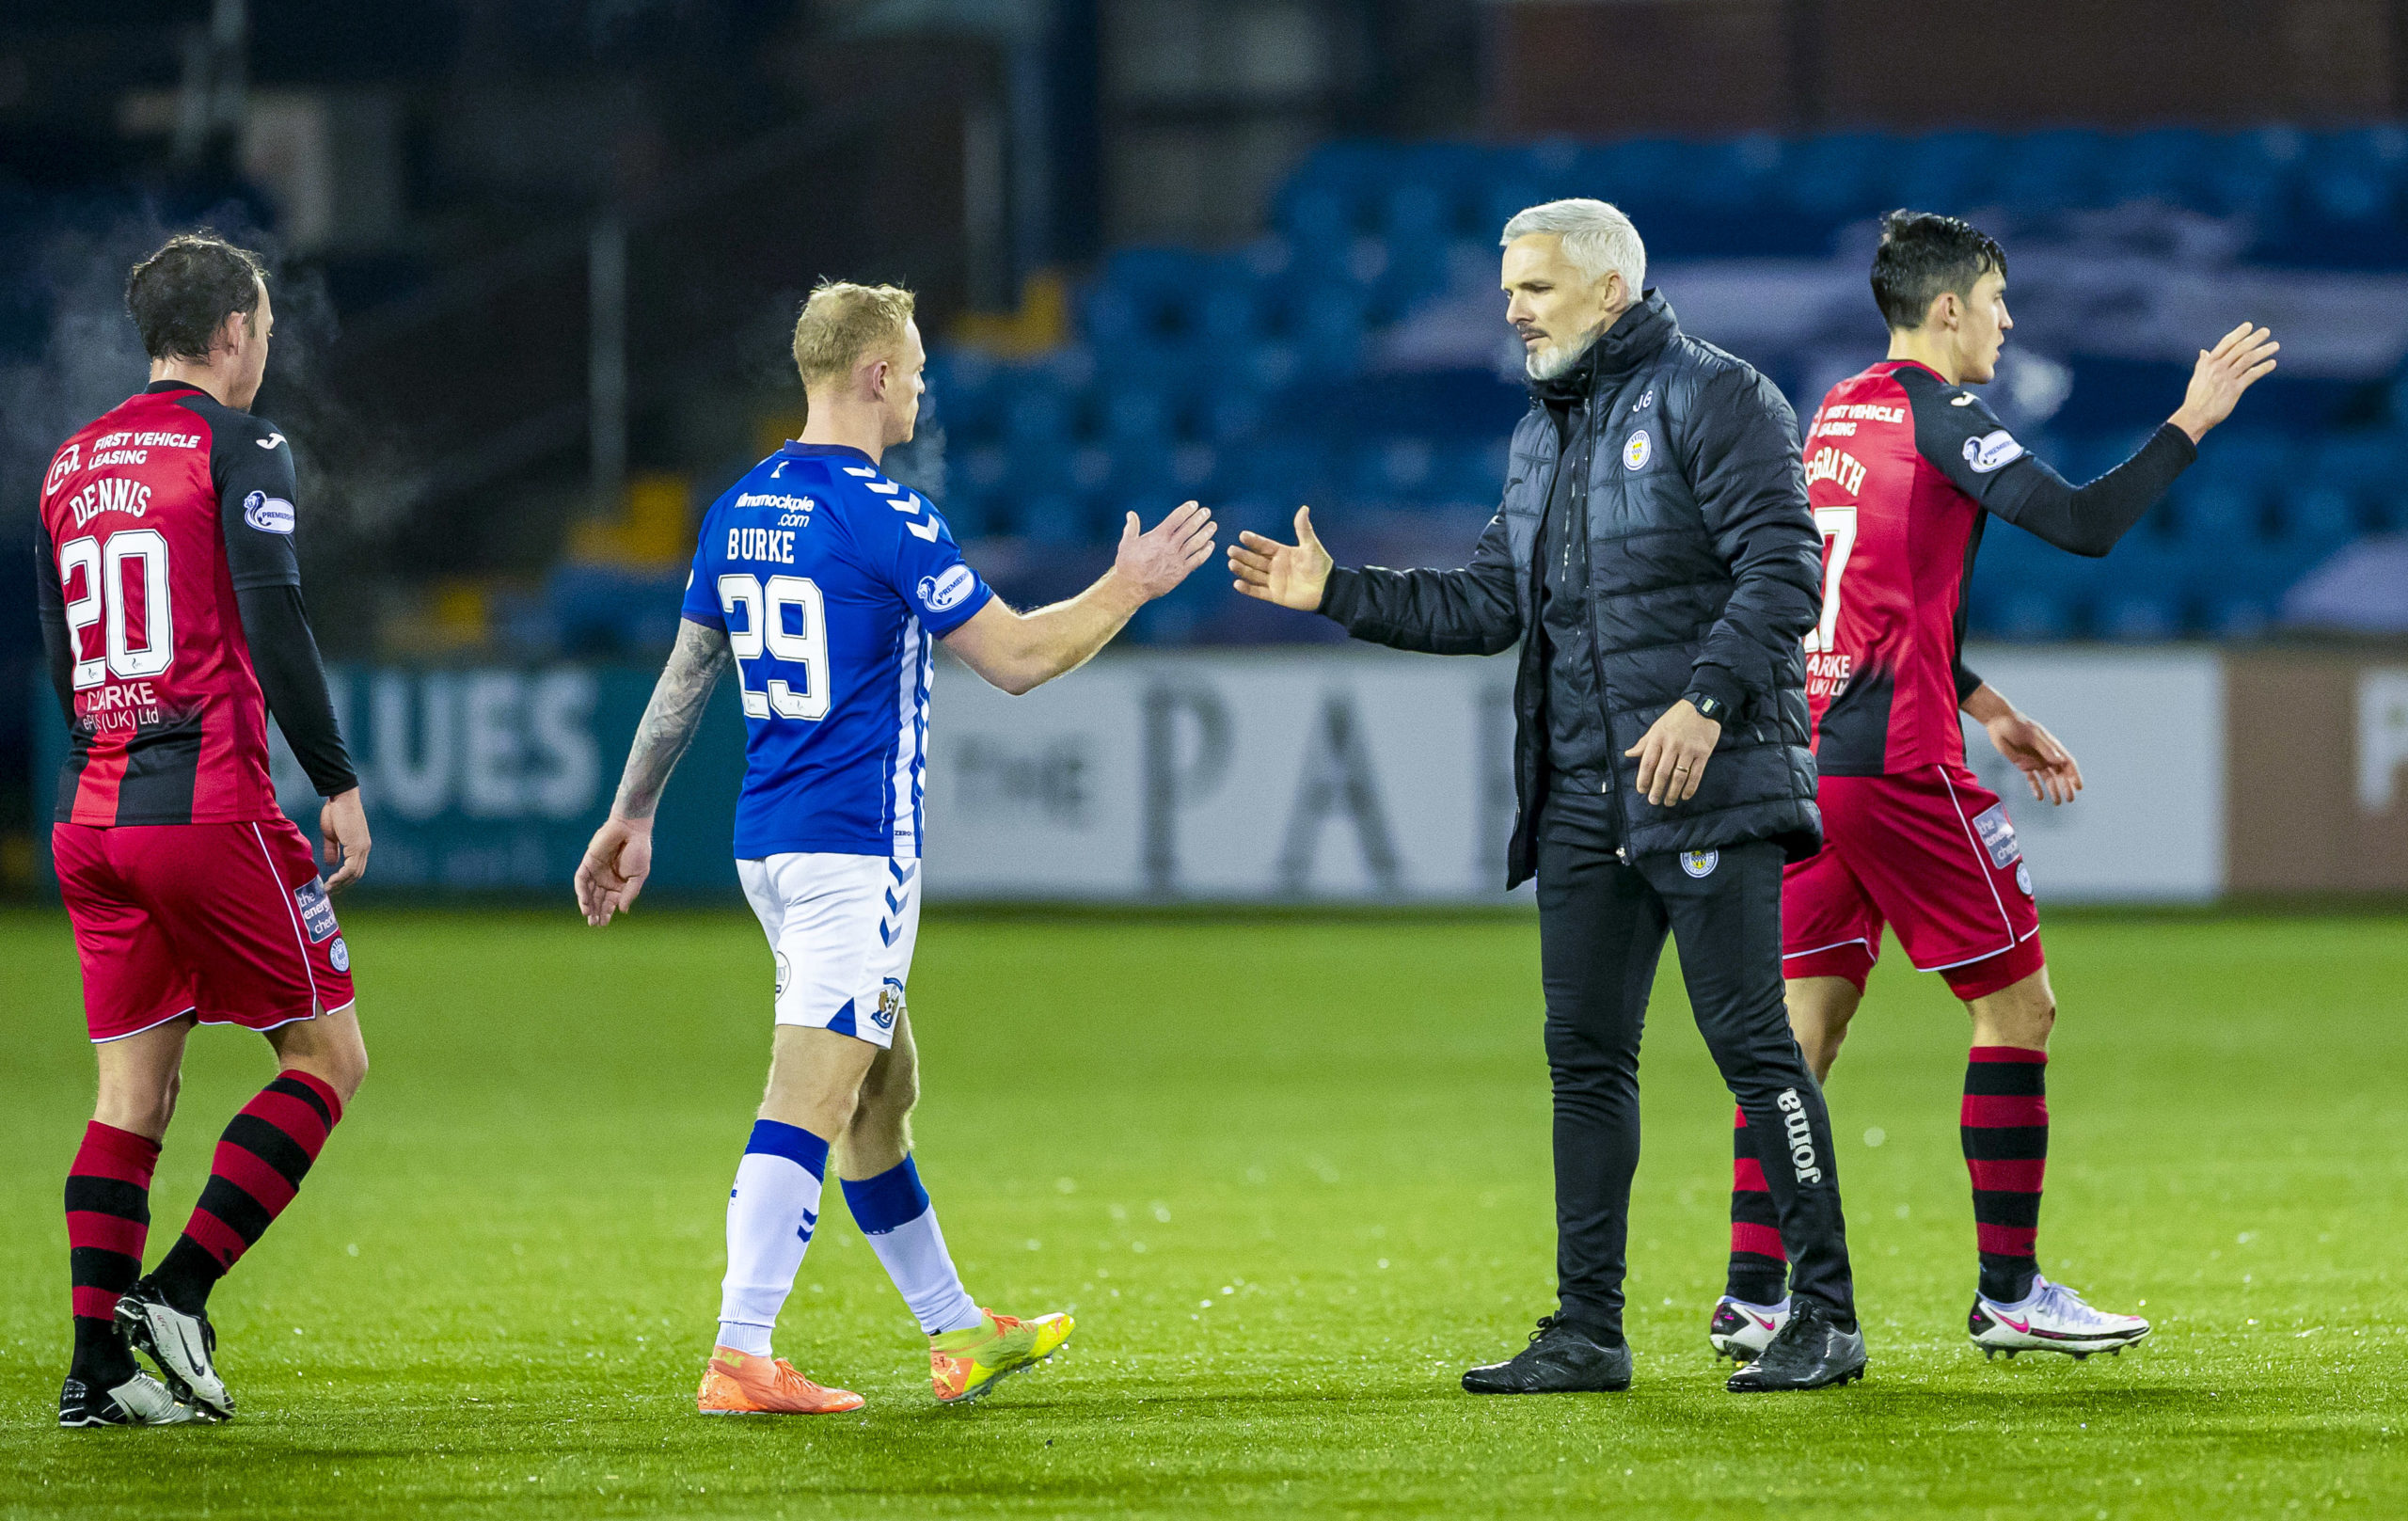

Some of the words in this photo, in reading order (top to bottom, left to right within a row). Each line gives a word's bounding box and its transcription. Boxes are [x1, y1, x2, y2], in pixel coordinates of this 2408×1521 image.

[1632, 390, 1653, 412] JG
[92, 432, 134, 453] FIRST
[134, 432, 201, 449] VEHICLE
[87, 450, 149, 471] LEASING
[69, 478, 151, 530] DENNIS
[777, 514, 810, 528] .com
[727, 528, 796, 564] BURKE
[59, 528, 174, 691] 20
[718, 573, 831, 721] 29
[102, 709, 135, 734] (UK)
[137, 706, 159, 725] Ltd
[297, 892, 316, 908] the
